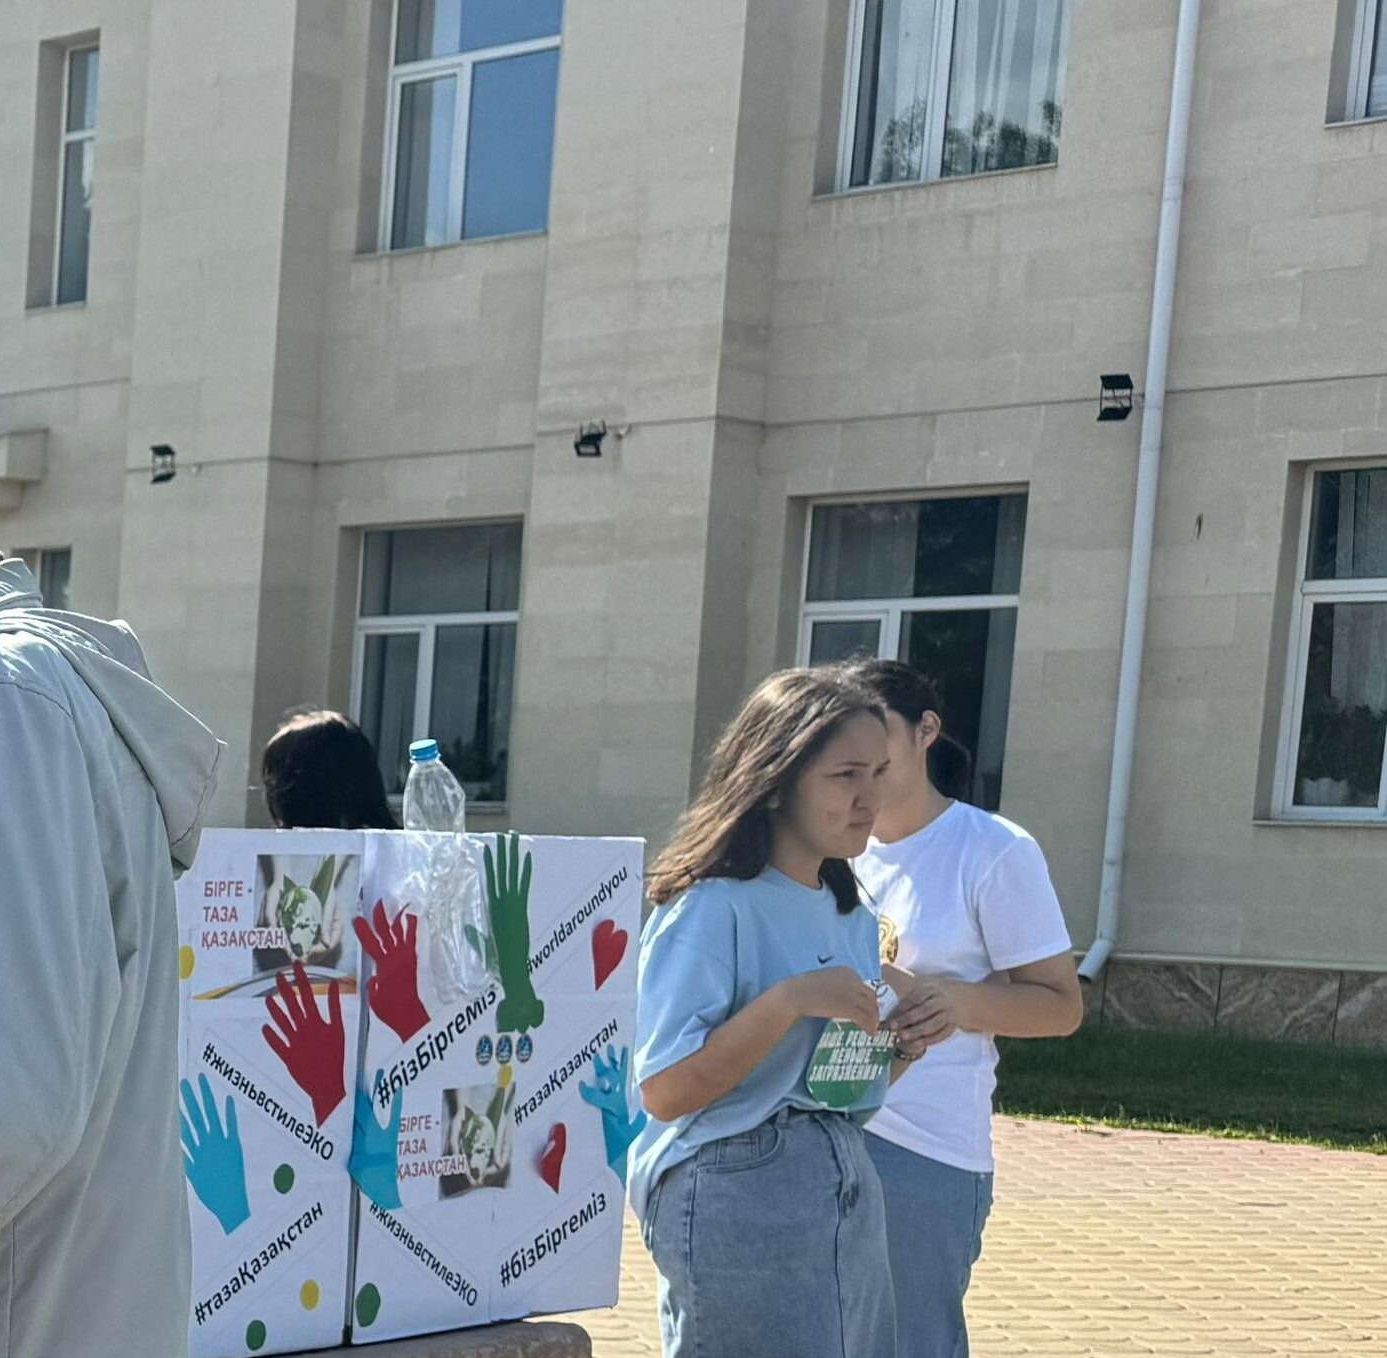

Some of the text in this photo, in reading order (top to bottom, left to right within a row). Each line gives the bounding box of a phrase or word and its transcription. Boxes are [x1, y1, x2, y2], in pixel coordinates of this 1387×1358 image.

[203, 906, 239, 923] ТАЗА
[204, 881, 244, 898] БІРГЕ
[201, 930, 285, 950] ҚАЗАҚСТАН
[377, 989, 497, 1109] #бізБіргеміз
[514, 1018, 619, 1127] #тазаҚазақстан
[202, 1042, 335, 1161] #жизньвстилеЭКО
[399, 1114, 432, 1133] БІРГЕ
[396, 1156, 467, 1182] ҚАЗАҚСТАН
[397, 1140, 427, 1157] ТАЗА
[194, 1200, 324, 1326] #тазаҚазақстан
[369, 1200, 478, 1307] #жизньвстилеЭКО
[500, 1191, 608, 1289] #бізБіргеміз
